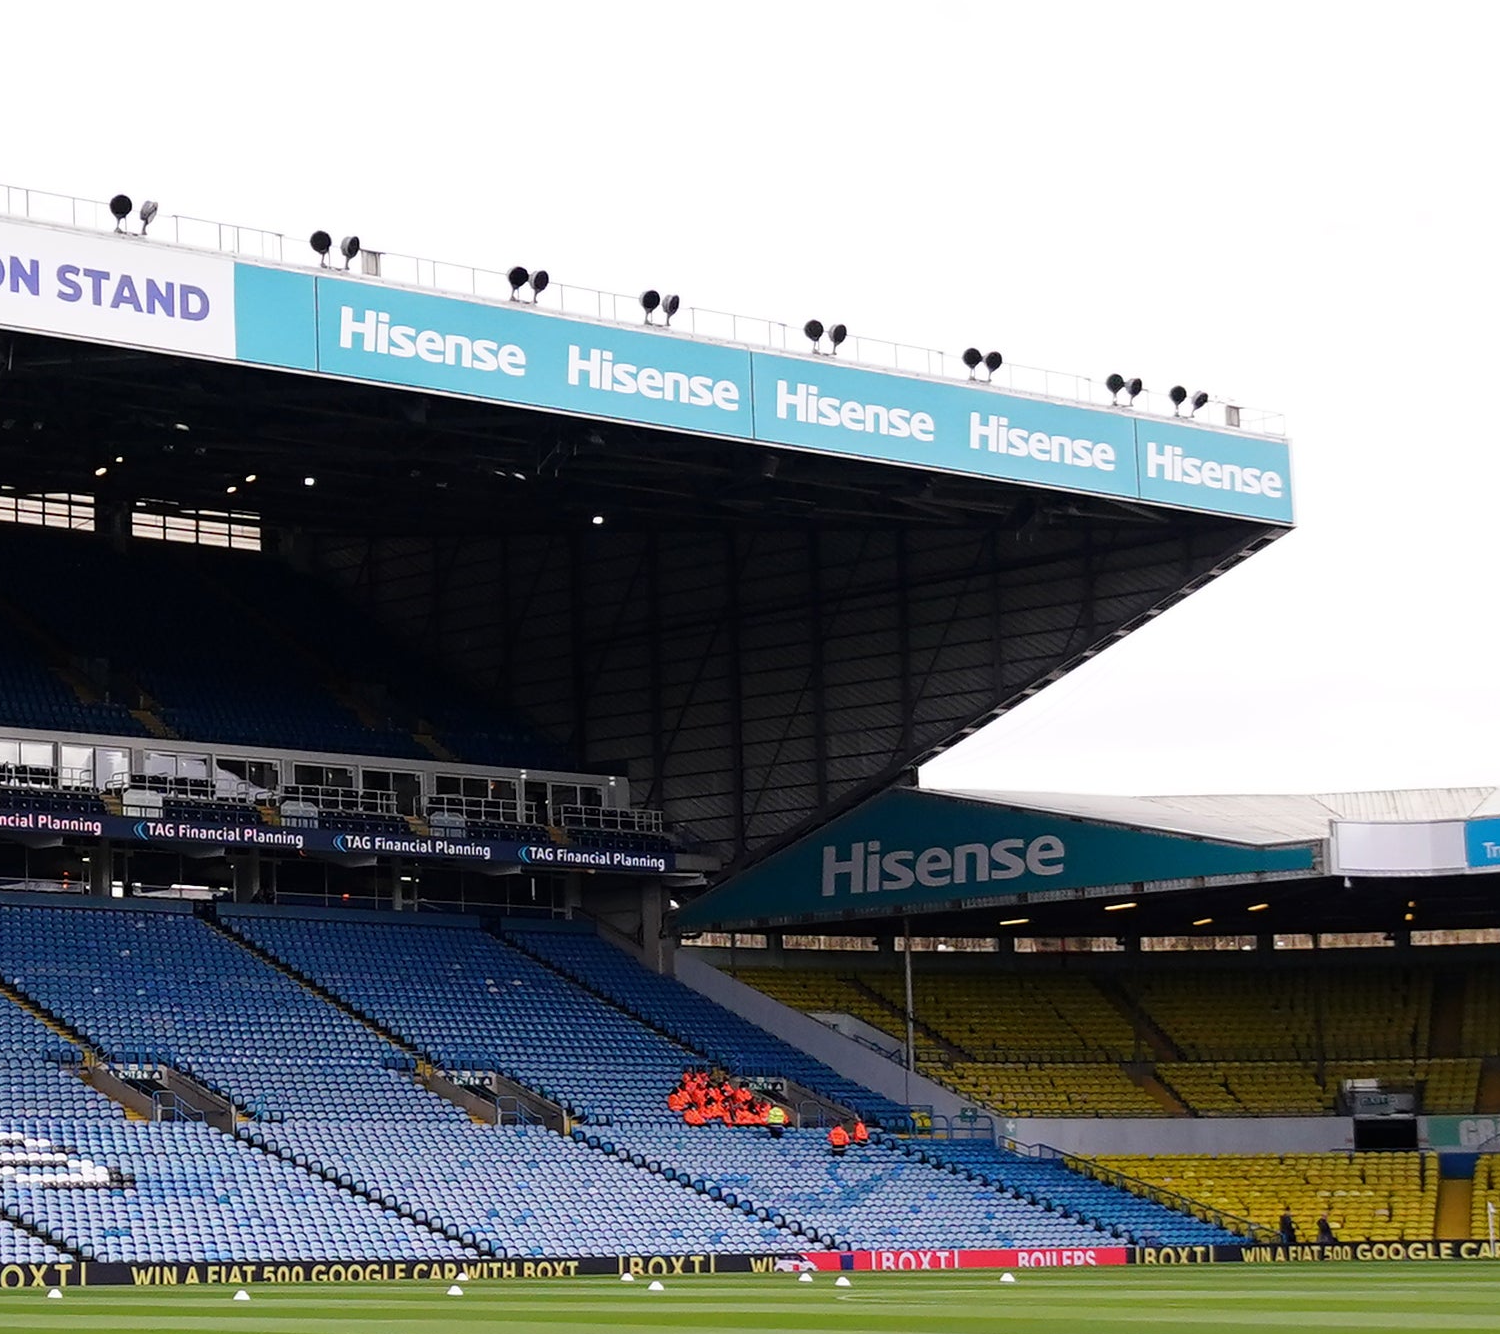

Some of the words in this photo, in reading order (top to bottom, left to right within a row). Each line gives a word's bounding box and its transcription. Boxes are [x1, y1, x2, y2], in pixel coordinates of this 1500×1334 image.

[56, 265, 210, 323] STAND
[339, 307, 527, 377] Hisense
[567, 344, 739, 411] Hisense
[775, 382, 935, 442] Hisense
[969, 411, 1115, 472] Hisense
[1147, 442, 1282, 497] Hisense
[38, 815, 101, 835] Planning
[147, 823, 174, 837] TAG
[179, 825, 240, 841] Financial
[244, 829, 303, 848] Planning
[345, 835, 371, 849] TAG
[375, 837, 432, 852] Financial
[436, 841, 490, 859] Planning
[530, 847, 553, 860] TAG
[557, 849, 610, 864] Financial
[614, 853, 665, 871] Planning
[822, 835, 1065, 896] Hisense
[883, 1251, 948, 1271] BOXT
[1145, 1247, 1206, 1264] BOXT
[1241, 1246, 1270, 1262] WIN
[1274, 1246, 1286, 1262] A
[1290, 1246, 1320, 1261] FIAT
[1324, 1245, 1351, 1260] 500
[1357, 1242, 1453, 1260] GOOGLE
[132, 1266, 179, 1286] WIN
[185, 1266, 199, 1285] A
[207, 1265, 257, 1285] FIAT
[263, 1264, 303, 1284] 500
[523, 1262, 579, 1280] BOXT
[630, 1256, 701, 1275] BOXT
[750, 1257, 780, 1273] WI
